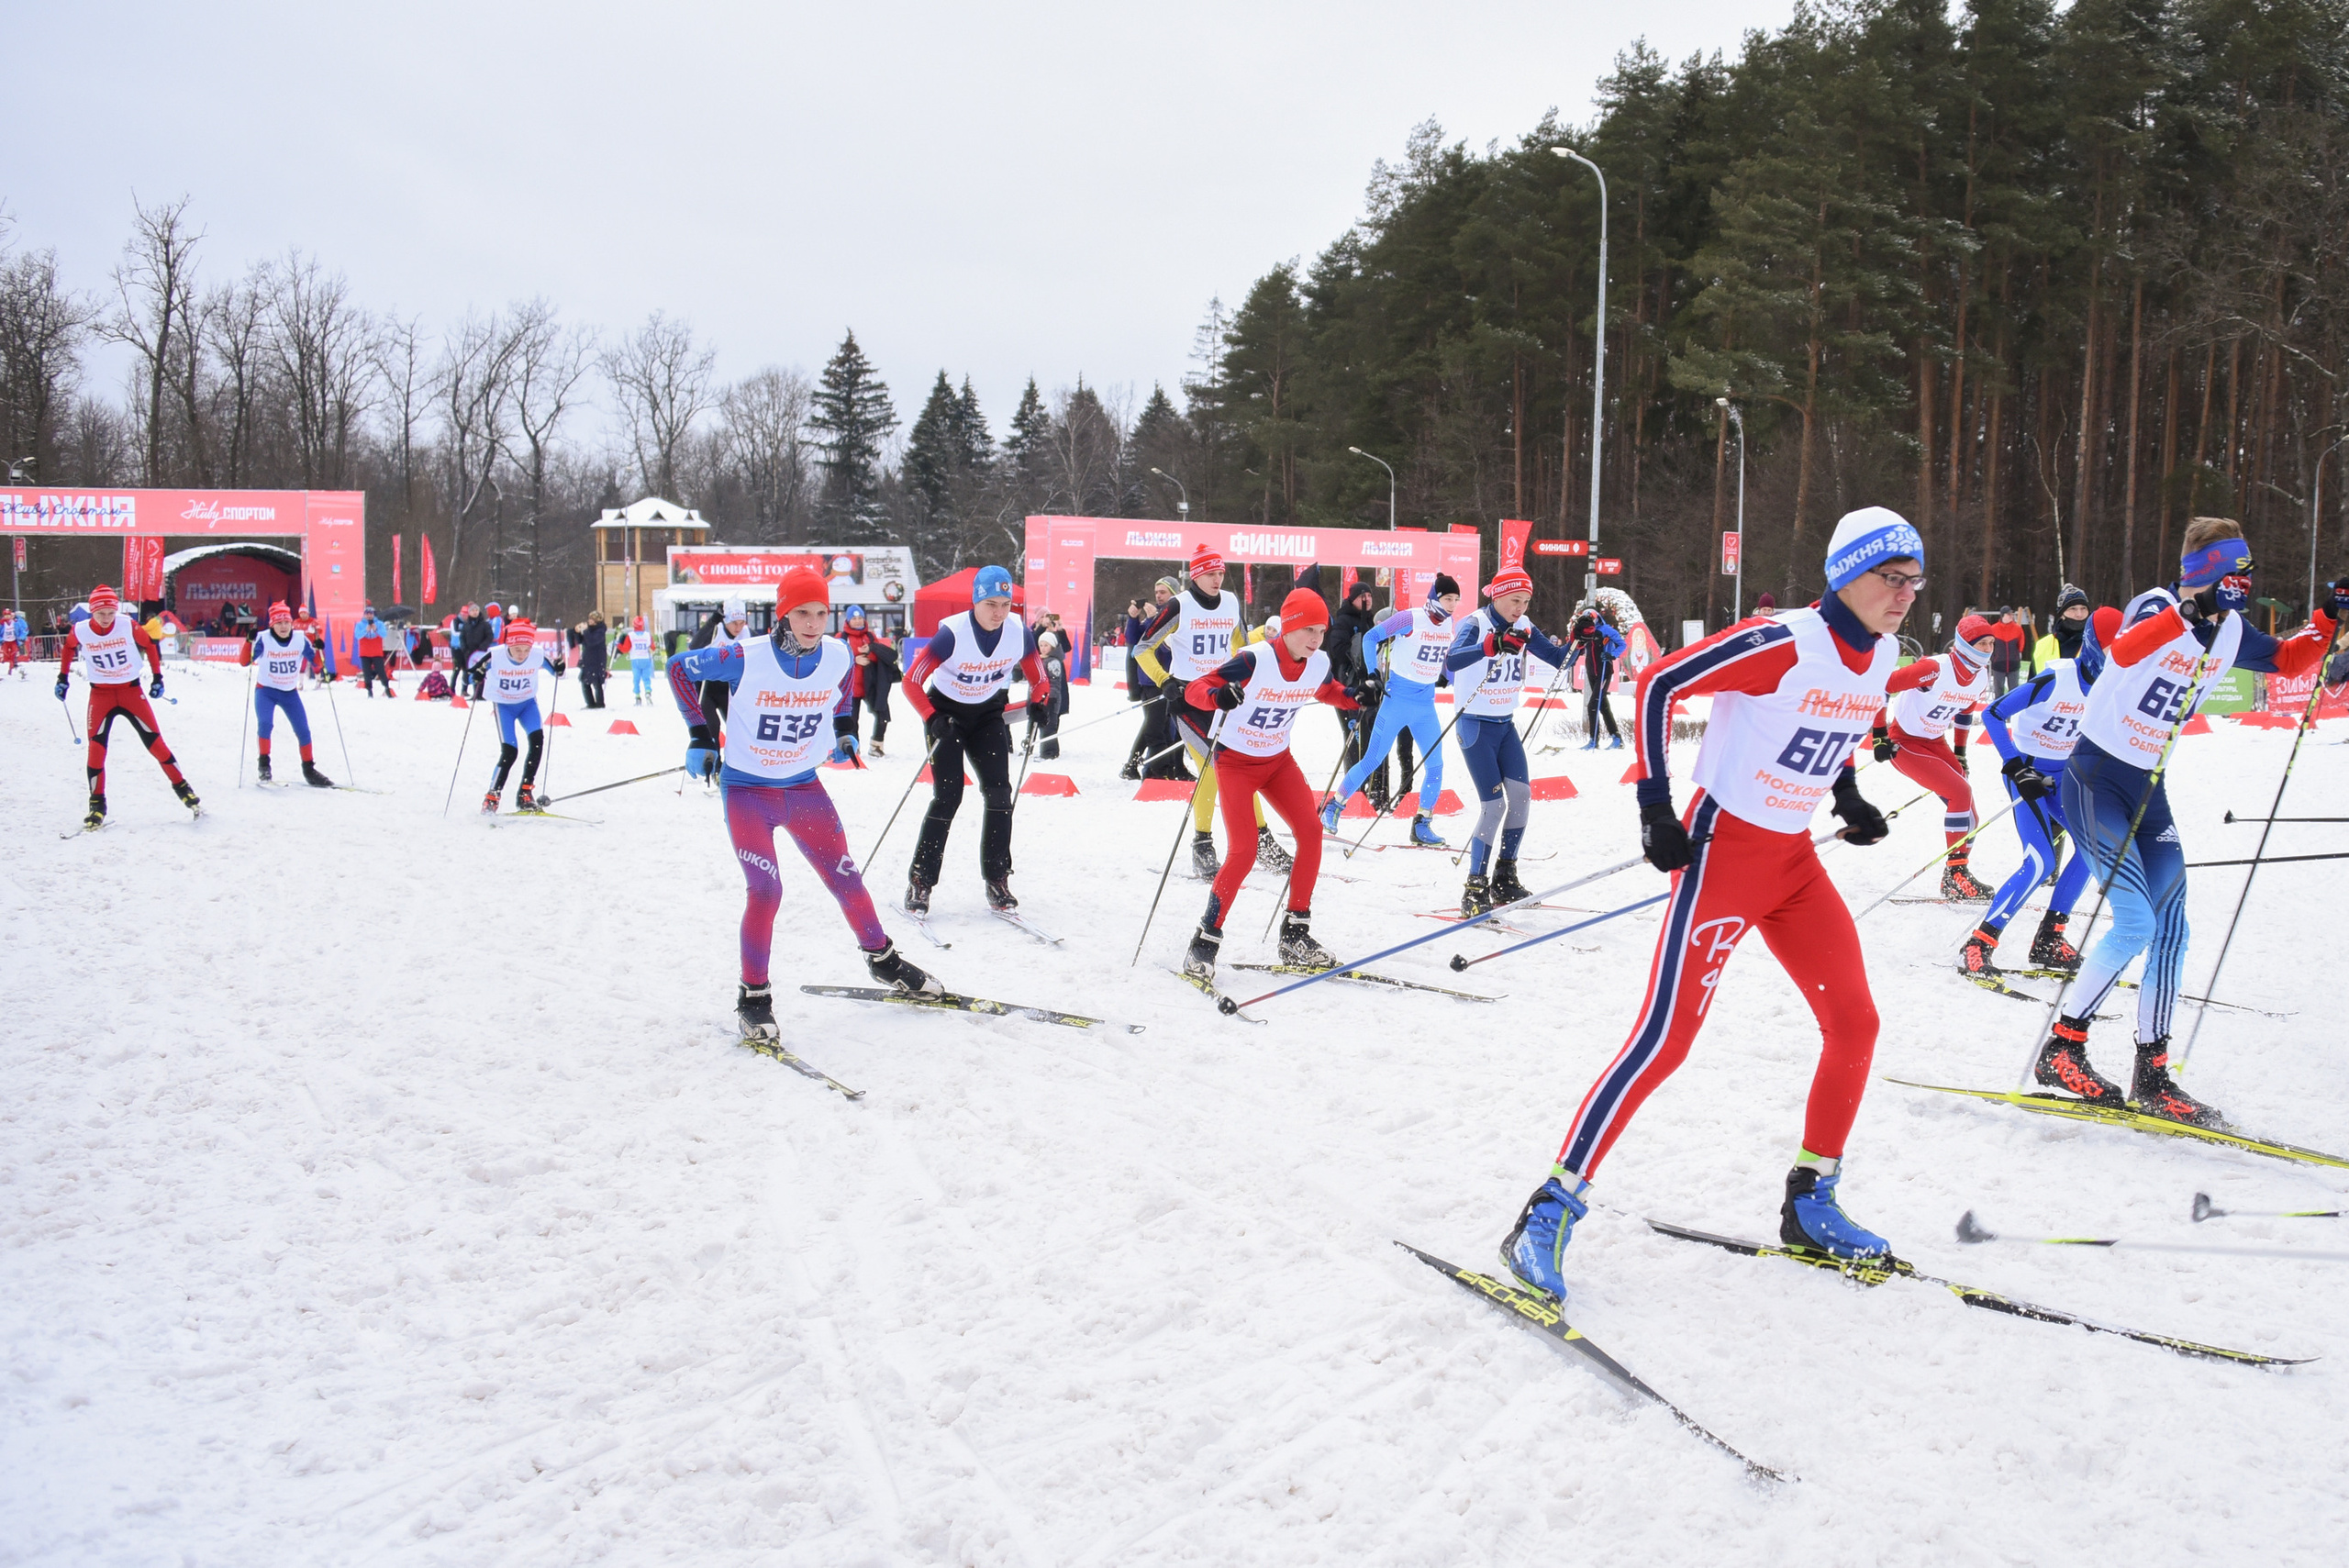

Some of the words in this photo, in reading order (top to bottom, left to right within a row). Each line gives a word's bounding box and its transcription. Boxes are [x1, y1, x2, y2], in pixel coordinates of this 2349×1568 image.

[180, 500, 220, 528] Живу
[223, 506, 275, 521] СПОРТОМ
[1125, 531, 1183, 548] ЛЫЖНЯ
[1230, 532, 1316, 557] ФИНИШ
[1361, 541, 1413, 556] ЛЫЖНЯ
[1538, 542, 1570, 552] ФИНИШ
[1825, 535, 1886, 582] ЫЖНЯ
[698, 563, 708, 575] С
[709, 562, 762, 575] НОВЫМ
[185, 583, 257, 600] ЛЫЖНЯ
[1190, 617, 1234, 630] ЛЫЖНЯ
[1193, 633, 1230, 655] 614
[1416, 644, 1448, 662] 635
[92, 650, 128, 669] 515
[269, 661, 298, 674] 608
[1487, 658, 1521, 684] 618
[498, 678, 531, 691] 642
[754, 689, 832, 708] ЛЫЖНЯ
[1255, 687, 1316, 703] ЛЫЖНЯ
[1247, 706, 1302, 730] 637
[2042, 716, 2083, 738] 61
[756, 712, 823, 744] 638
[738, 848, 778, 881] LUKOIL
[2050, 1050, 2105, 1097] ROSSI
[2071, 1103, 2139, 1123] FISCHER
[1454, 1269, 1560, 1328] FISCHER
